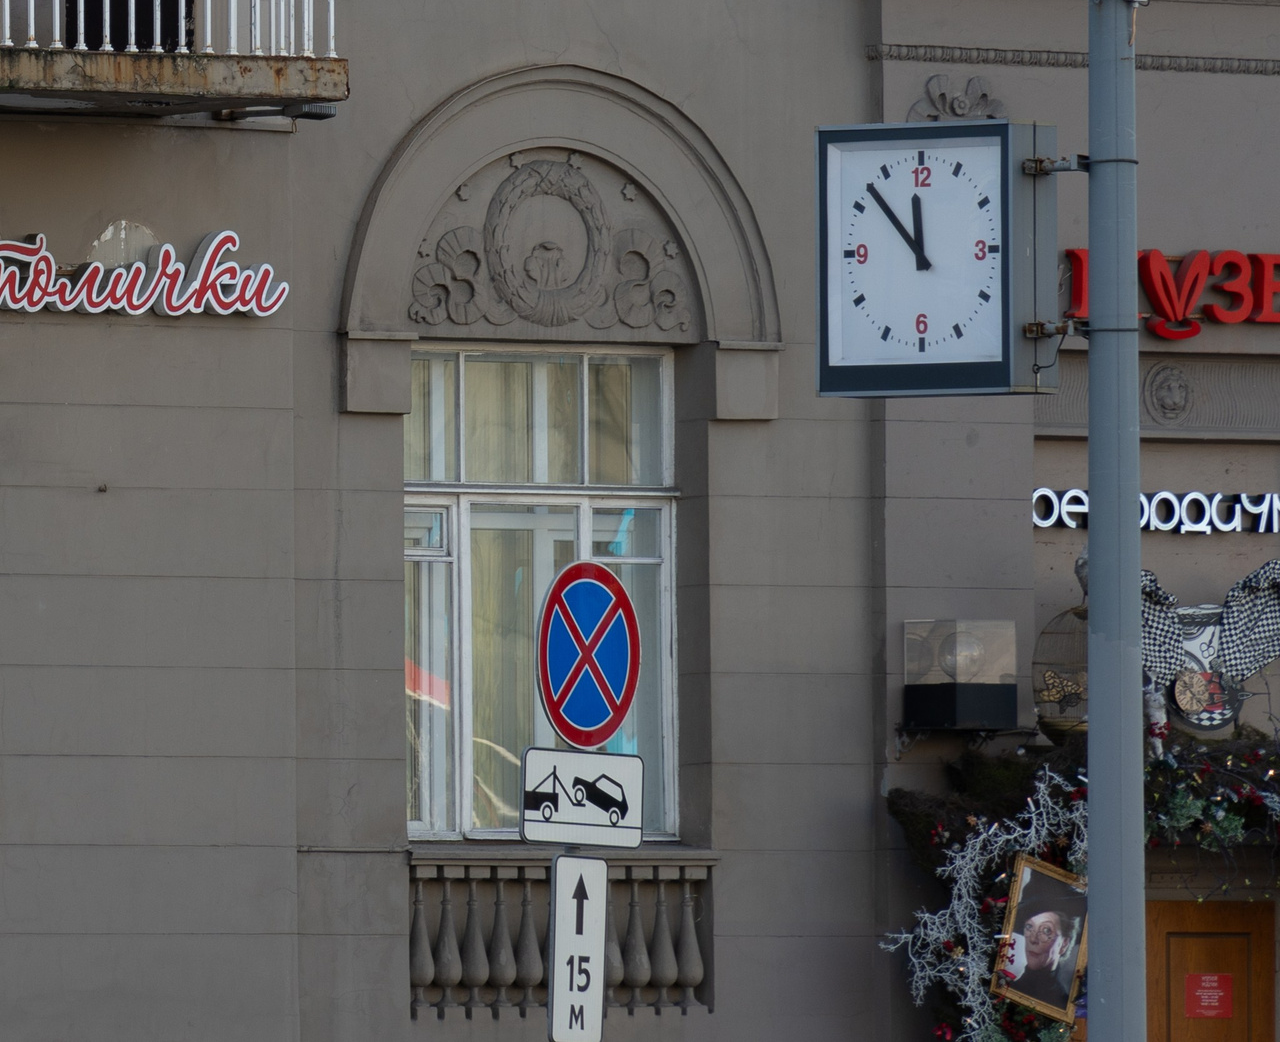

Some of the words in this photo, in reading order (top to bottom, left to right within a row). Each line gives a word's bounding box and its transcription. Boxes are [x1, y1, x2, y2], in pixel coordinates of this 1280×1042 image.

[911, 166, 932, 188] 12
[855, 243, 869, 265] 9
[973, 239, 988, 261] 3
[915, 313, 929, 335] 6
[566, 954, 591, 993] 15
